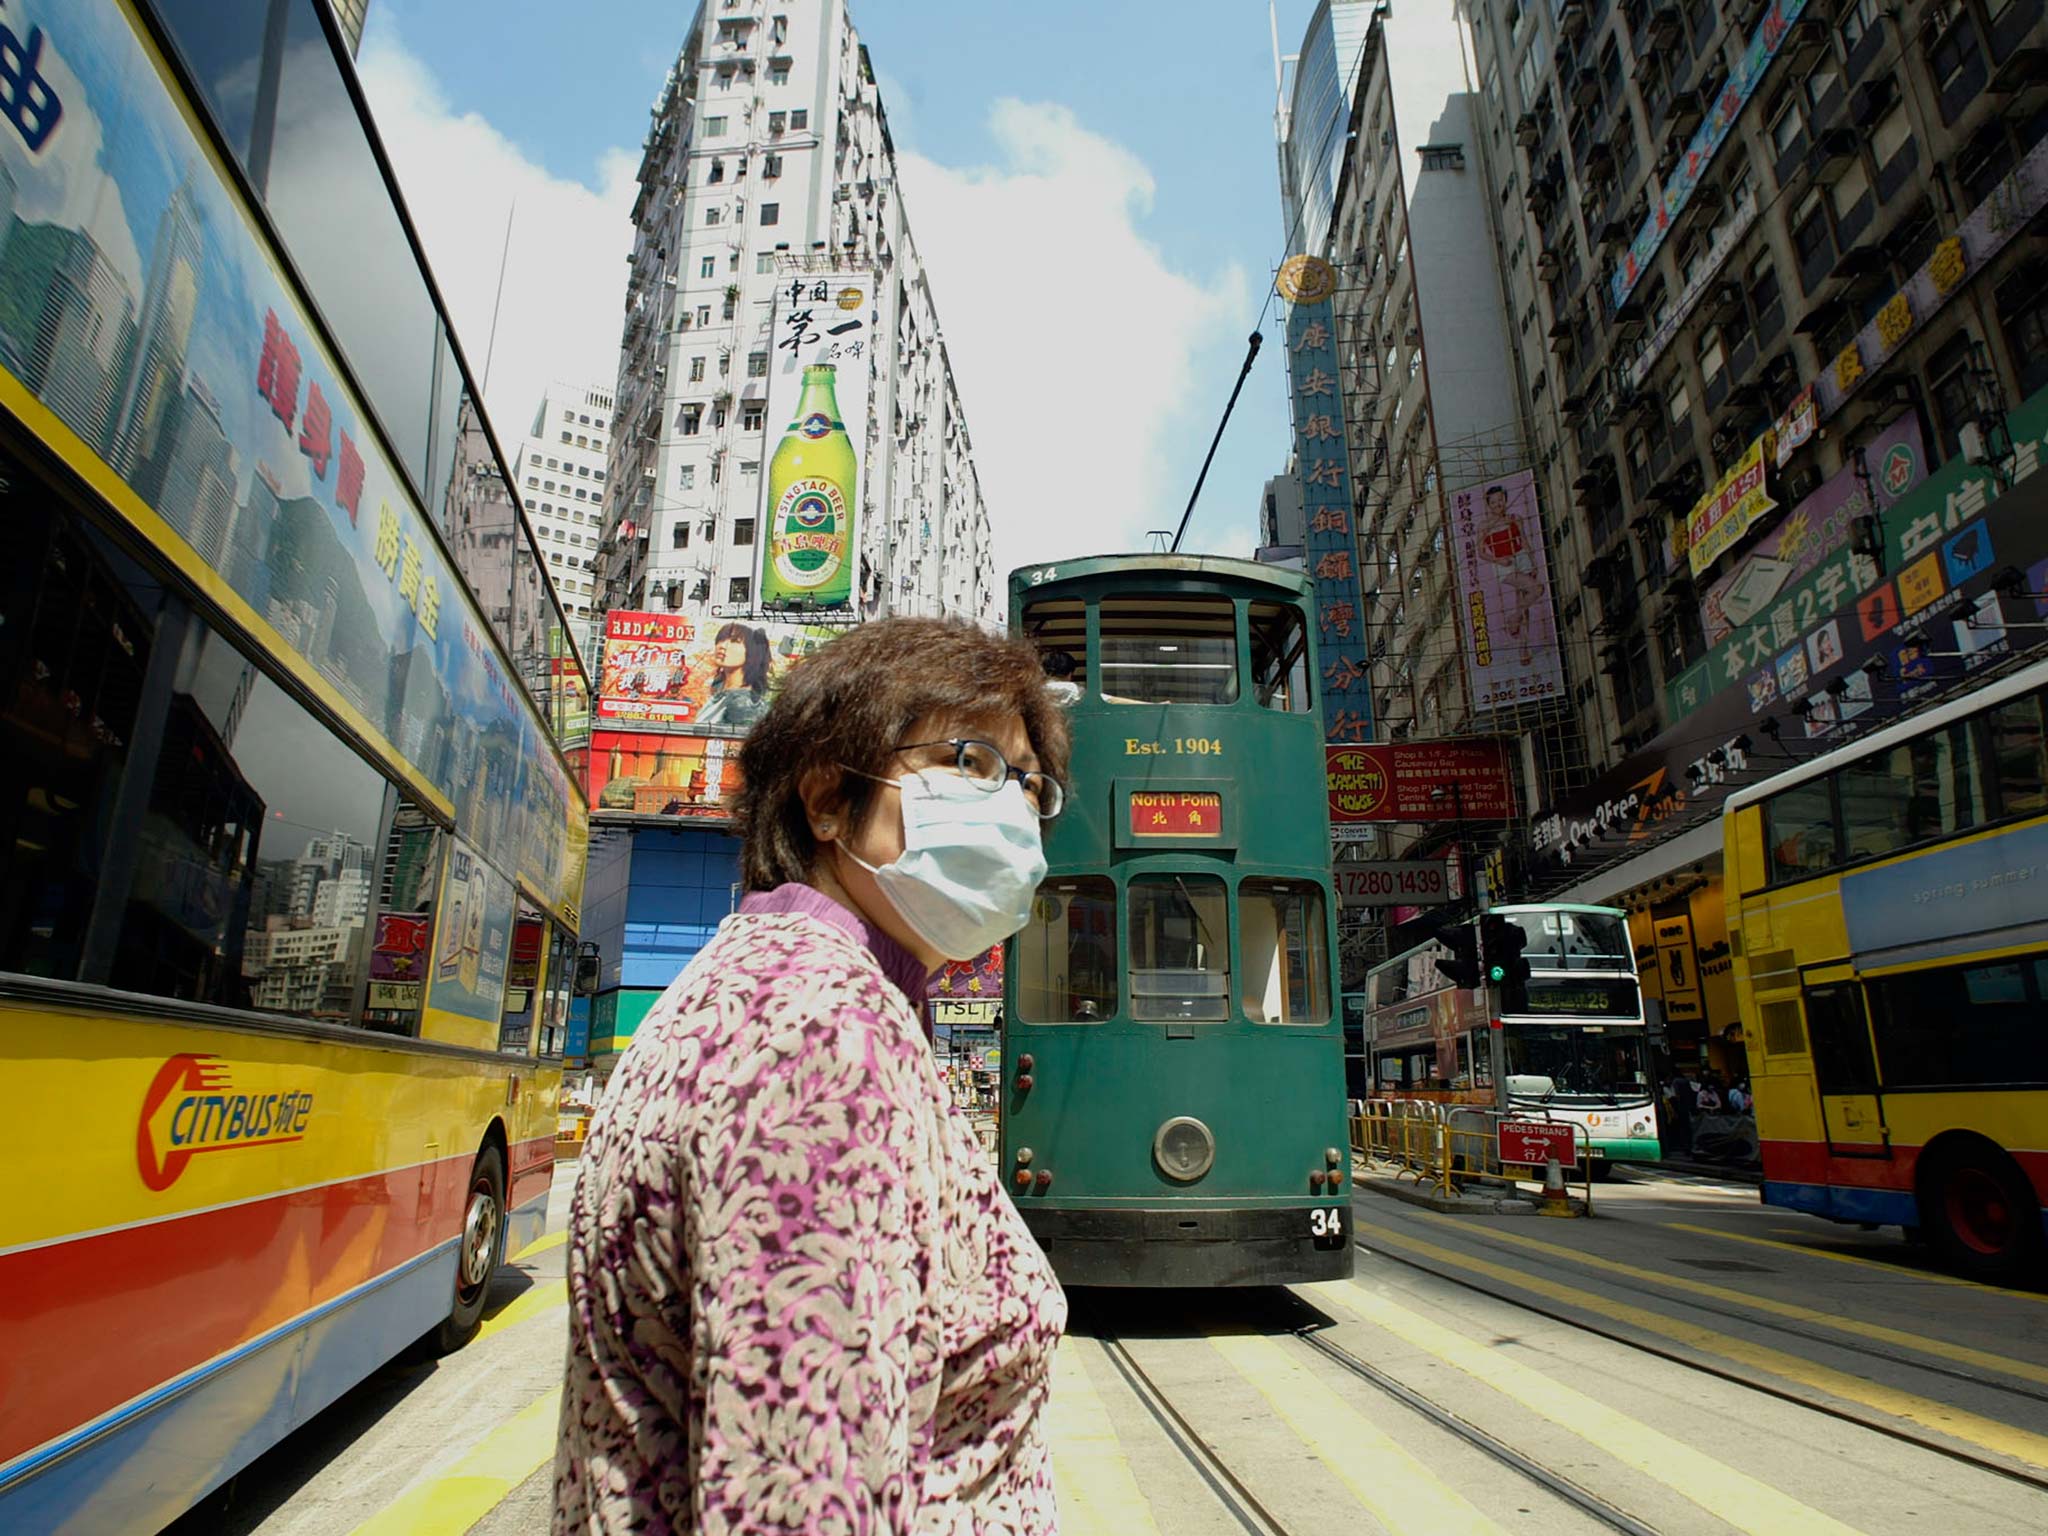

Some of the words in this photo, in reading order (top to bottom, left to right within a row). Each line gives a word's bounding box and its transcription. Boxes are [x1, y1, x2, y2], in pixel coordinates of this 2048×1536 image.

[778, 480, 828, 520] TSINGTAO
[827, 489, 845, 521] BEER
[1031, 566, 1058, 586] 34
[612, 620, 643, 637] RED
[666, 625, 696, 641] BOX
[1124, 738, 1167, 756] Est.
[1174, 738, 1222, 756] 1904
[1336, 754, 1366, 771] THE
[1328, 771, 1383, 791] SPAGHETTI
[1131, 793, 1176, 807] North
[1181, 793, 1220, 807] Point
[1338, 793, 1376, 811] HOUSE
[1151, 810, 1202, 825] 北角
[1346, 870, 1393, 895] 7280
[1397, 870, 1441, 893] 1439
[944, 1002, 980, 1015] TSL
[1588, 992, 1609, 1009] 25
[170, 1094, 278, 1146] CITYBUS
[275, 1090, 314, 1135] 城巴
[1503, 1124, 1569, 1137] PEDESTRIANS
[1523, 1148, 1550, 1162] 行人
[1310, 1208, 1342, 1236] 34
